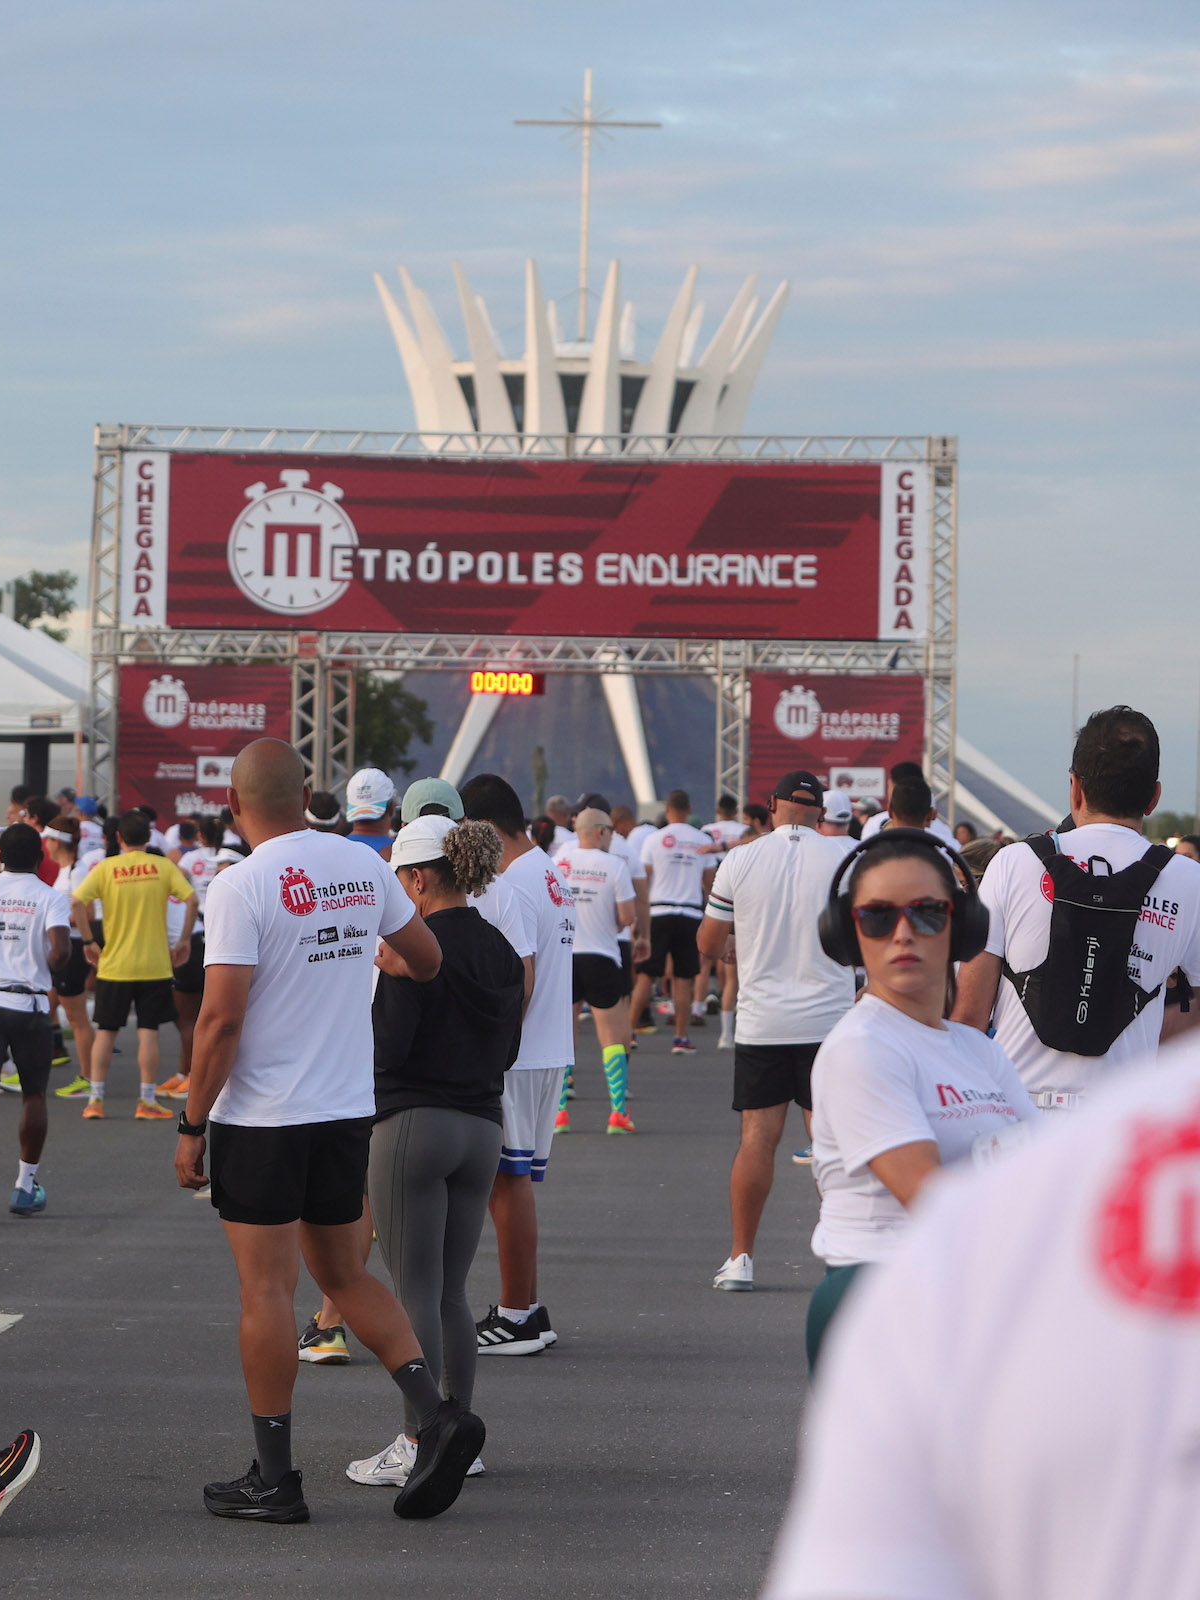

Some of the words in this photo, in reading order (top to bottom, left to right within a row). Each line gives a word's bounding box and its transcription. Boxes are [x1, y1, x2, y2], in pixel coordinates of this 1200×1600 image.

[133, 459, 154, 617] CHEGADA
[263, 522, 584, 585] METRÓPOLES
[595, 551, 819, 588] ENDURANCE
[893, 470, 915, 630] CHEGADA
[156, 693, 267, 716] METRÓPOLES
[787, 704, 901, 726] METRÓPOLES
[188, 714, 266, 731] ENDURANCE
[820, 724, 900, 741] ENDURANCE
[857, 776, 880, 788] GDF
[288, 881, 376, 907] METRÓPOLES
[321, 894, 377, 912] ENDURANCE
[1137, 909, 1177, 931] RANCE
[308, 950, 336, 963] CAIXA
[1079, 935, 1101, 998] Kalenji
[1130, 949, 1154, 963] ASÍLIA
